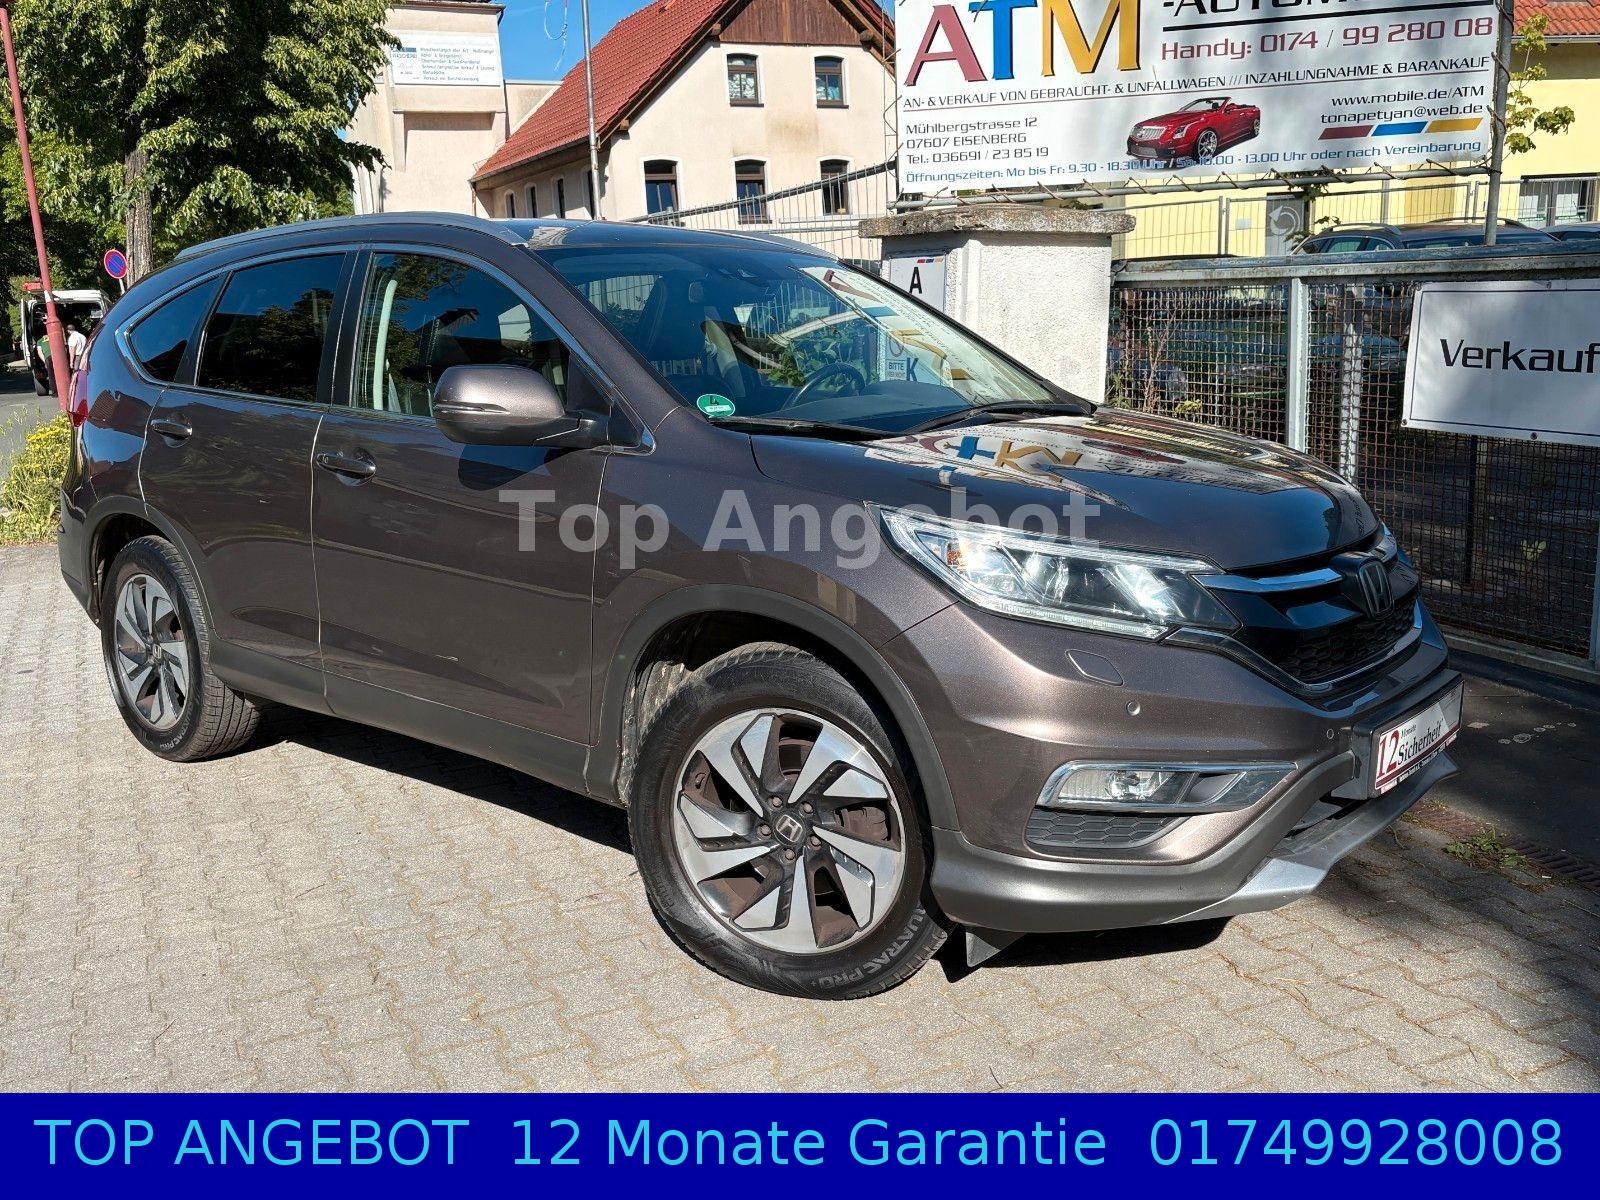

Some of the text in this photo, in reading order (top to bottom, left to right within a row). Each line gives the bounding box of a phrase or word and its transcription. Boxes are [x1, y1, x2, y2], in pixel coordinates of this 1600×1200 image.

[904, 0, 1141, 87] ATM
[1161, 38, 1252, 61] Handy:
[1260, 30, 1318, 53] 0174
[1342, 25, 1379, 47] 99
[1387, 20, 1446, 43] 280
[1454, 16, 1493, 37] 08
[903, 98, 925, 108] AN-
[927, 96, 936, 107] &
[938, 92, 997, 106] VERKAUF
[1000, 90, 1027, 102] VON
[1030, 85, 1111, 100] GEBRAUCHT-
[1114, 83, 1124, 94] &
[1127, 75, 1226, 93] UNFALLWAGEN
[1245, 64, 1379, 85] INZAHLUNGNAHME
[1382, 64, 1393, 74] &
[1398, 56, 1490, 73] BARANKAUF
[1331, 85, 1484, 107] www.mobile.de/ATM
[906, 117, 1038, 136] Mühlbergstrasse 12
[1321, 103, 1483, 124] tonapetyan@web.de
[906, 132, 1027, 150] 07607 EISENBERG
[906, 153, 929, 165] Tel.:
[932, 150, 981, 163] 036691
[992, 148, 1009, 160] 23
[1013, 147, 1032, 159] 85
[1036, 146, 1049, 158] 19
[906, 168, 1004, 184] Öffnungszeiten:
[1006, 167, 1025, 178] Mo
[1029, 165, 1047, 176] bis
[1068, 162, 1097, 174] 9.30
[1245, 152, 1279, 163] 13.00
[1284, 152, 1305, 162] Uhr
[1310, 150, 1345, 161] oder
[1346, 147, 1381, 158] nach
[1385, 141, 1481, 156] Vereinbarung
[909, 266, 923, 294] A
[1440, 338, 1600, 374] Verkauf
[1377, 729, 1400, 778] 12
